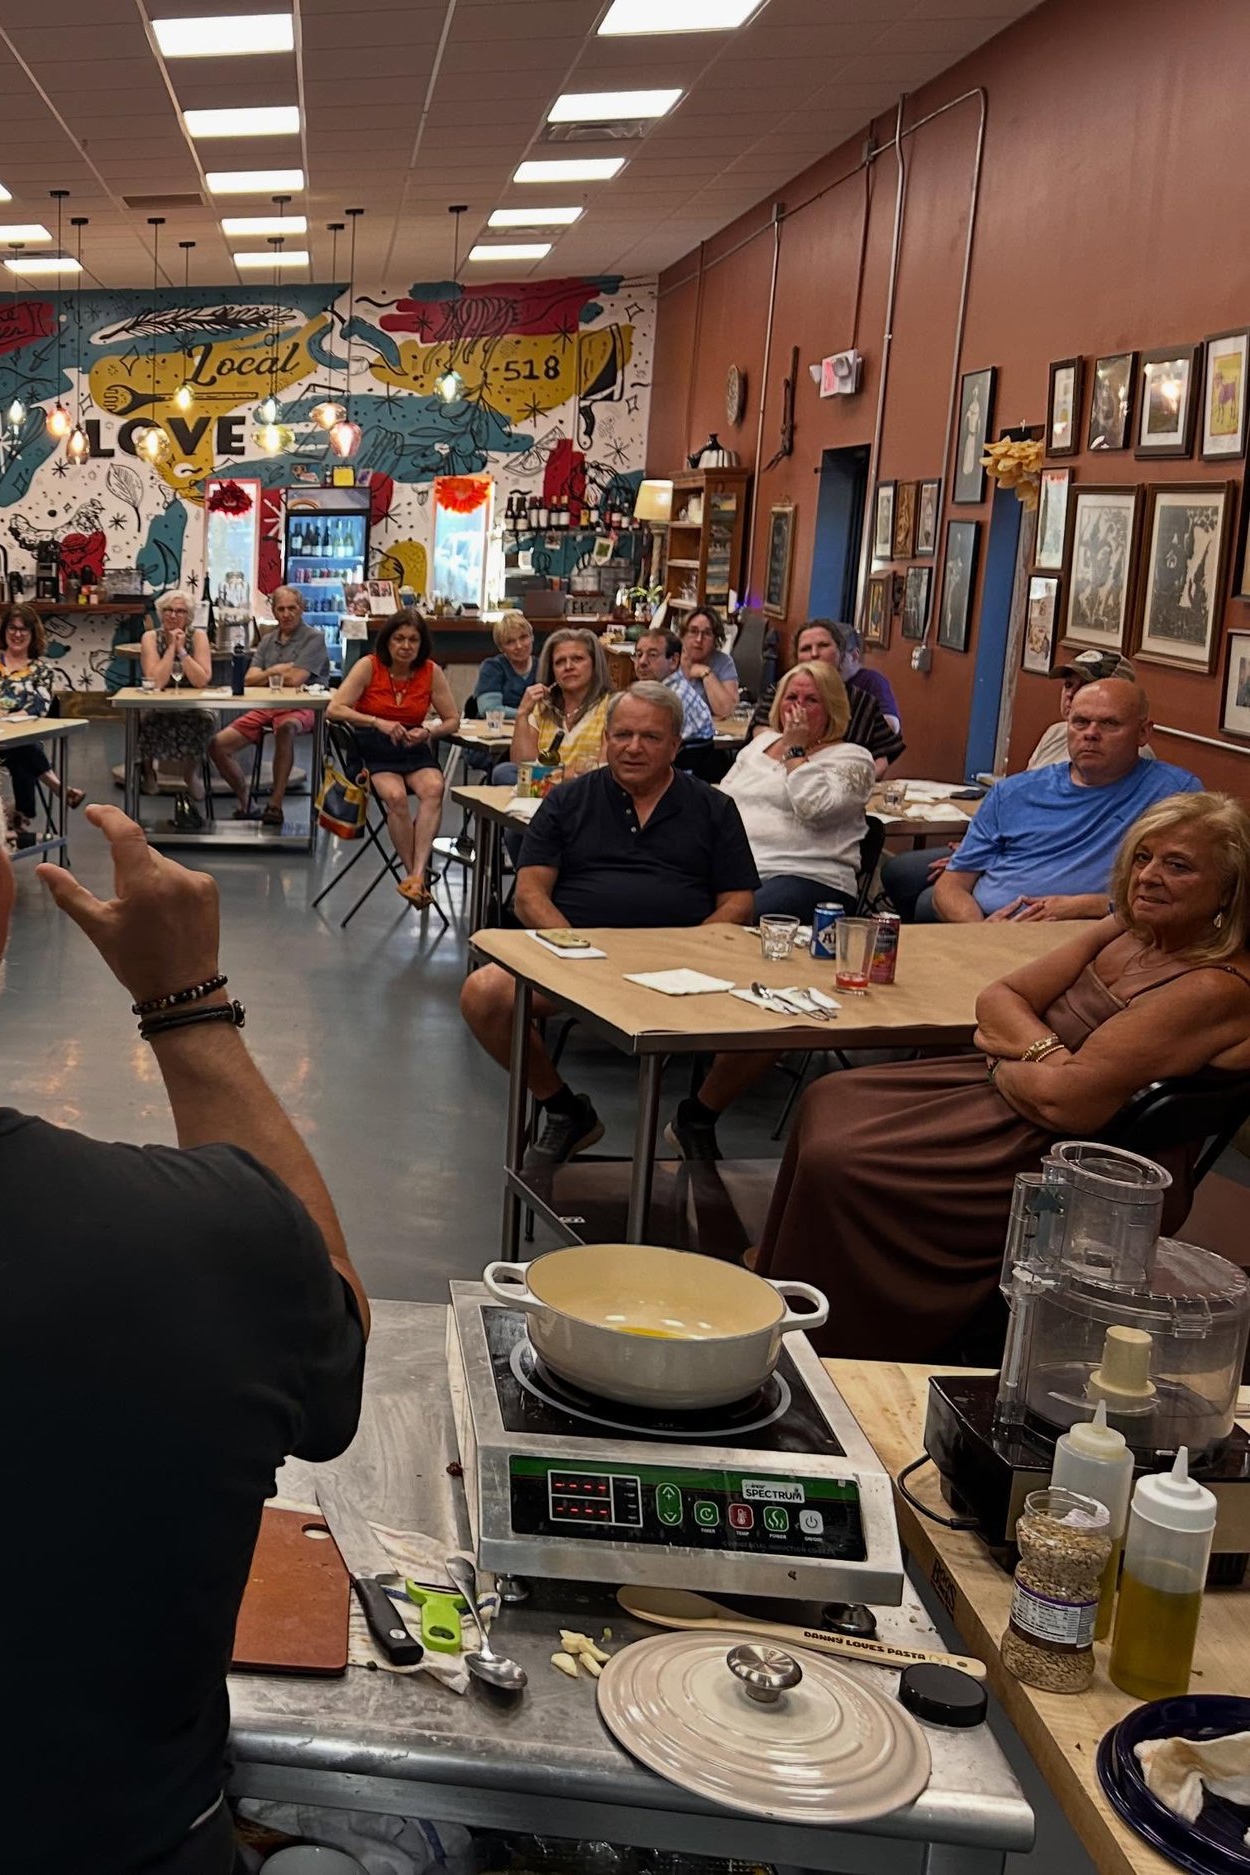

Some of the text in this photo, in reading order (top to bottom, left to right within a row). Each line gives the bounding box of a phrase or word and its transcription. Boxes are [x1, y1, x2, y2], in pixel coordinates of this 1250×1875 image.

[184, 342, 300, 386] Local
[86, 416, 246, 458] LOVE
[745, 1488, 803, 1502] SPECTRUM
[803, 1631, 926, 1661] DANNY LOVES PASTA
